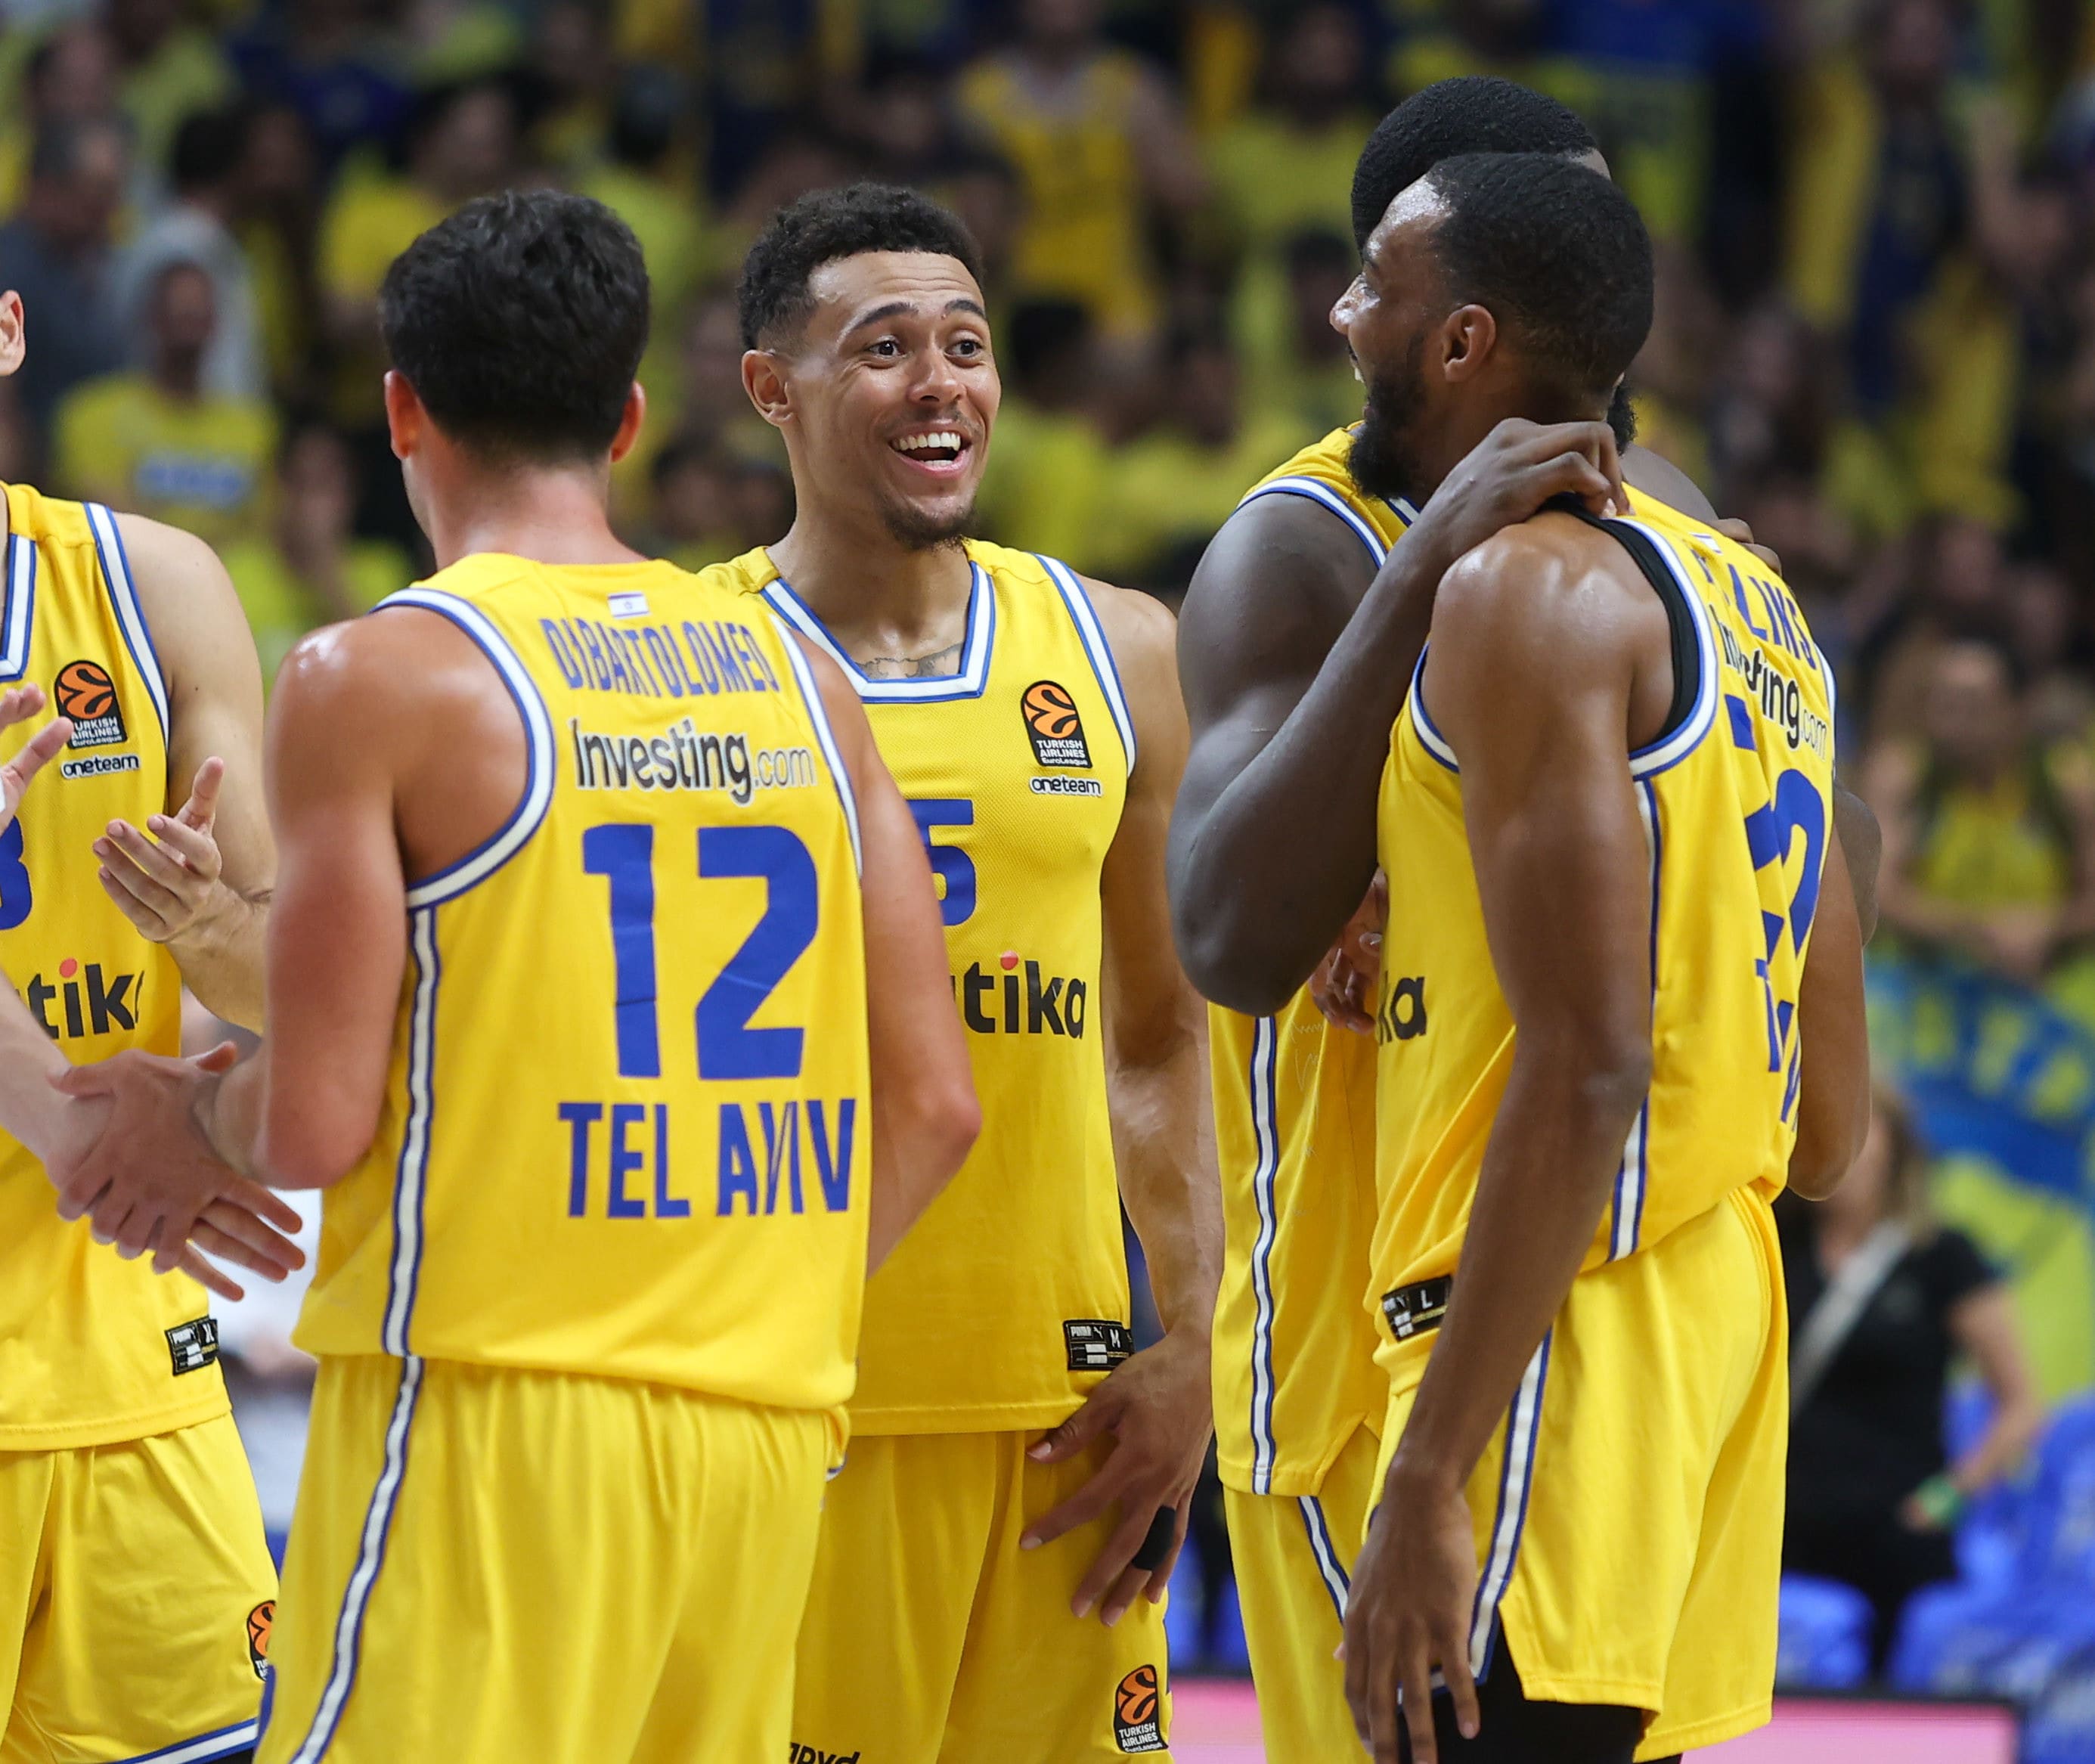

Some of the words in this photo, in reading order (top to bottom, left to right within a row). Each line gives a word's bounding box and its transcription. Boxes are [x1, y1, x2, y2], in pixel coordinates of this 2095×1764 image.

[73, 718, 118, 731] URKISH
[1037, 739, 1083, 749] TURKISH
[1040, 749, 1086, 758] AIRLINES
[63, 755, 139, 777] oneteam
[568, 718, 817, 804] Investing.com
[1042, 757, 1089, 766] EuroLeague
[1031, 777, 1102, 795] oneteam
[582, 823, 820, 1081] 12
[17, 957, 145, 1040] tik
[950, 951, 1086, 1040] tika
[558, 1101, 691, 1219] TEL
[717, 1098, 857, 1217] AVIV
[1421, 1288, 1433, 1310] L
[1119, 1722, 1156, 1739] TURKISH
[1122, 1731, 1158, 1748] AIRLINES
